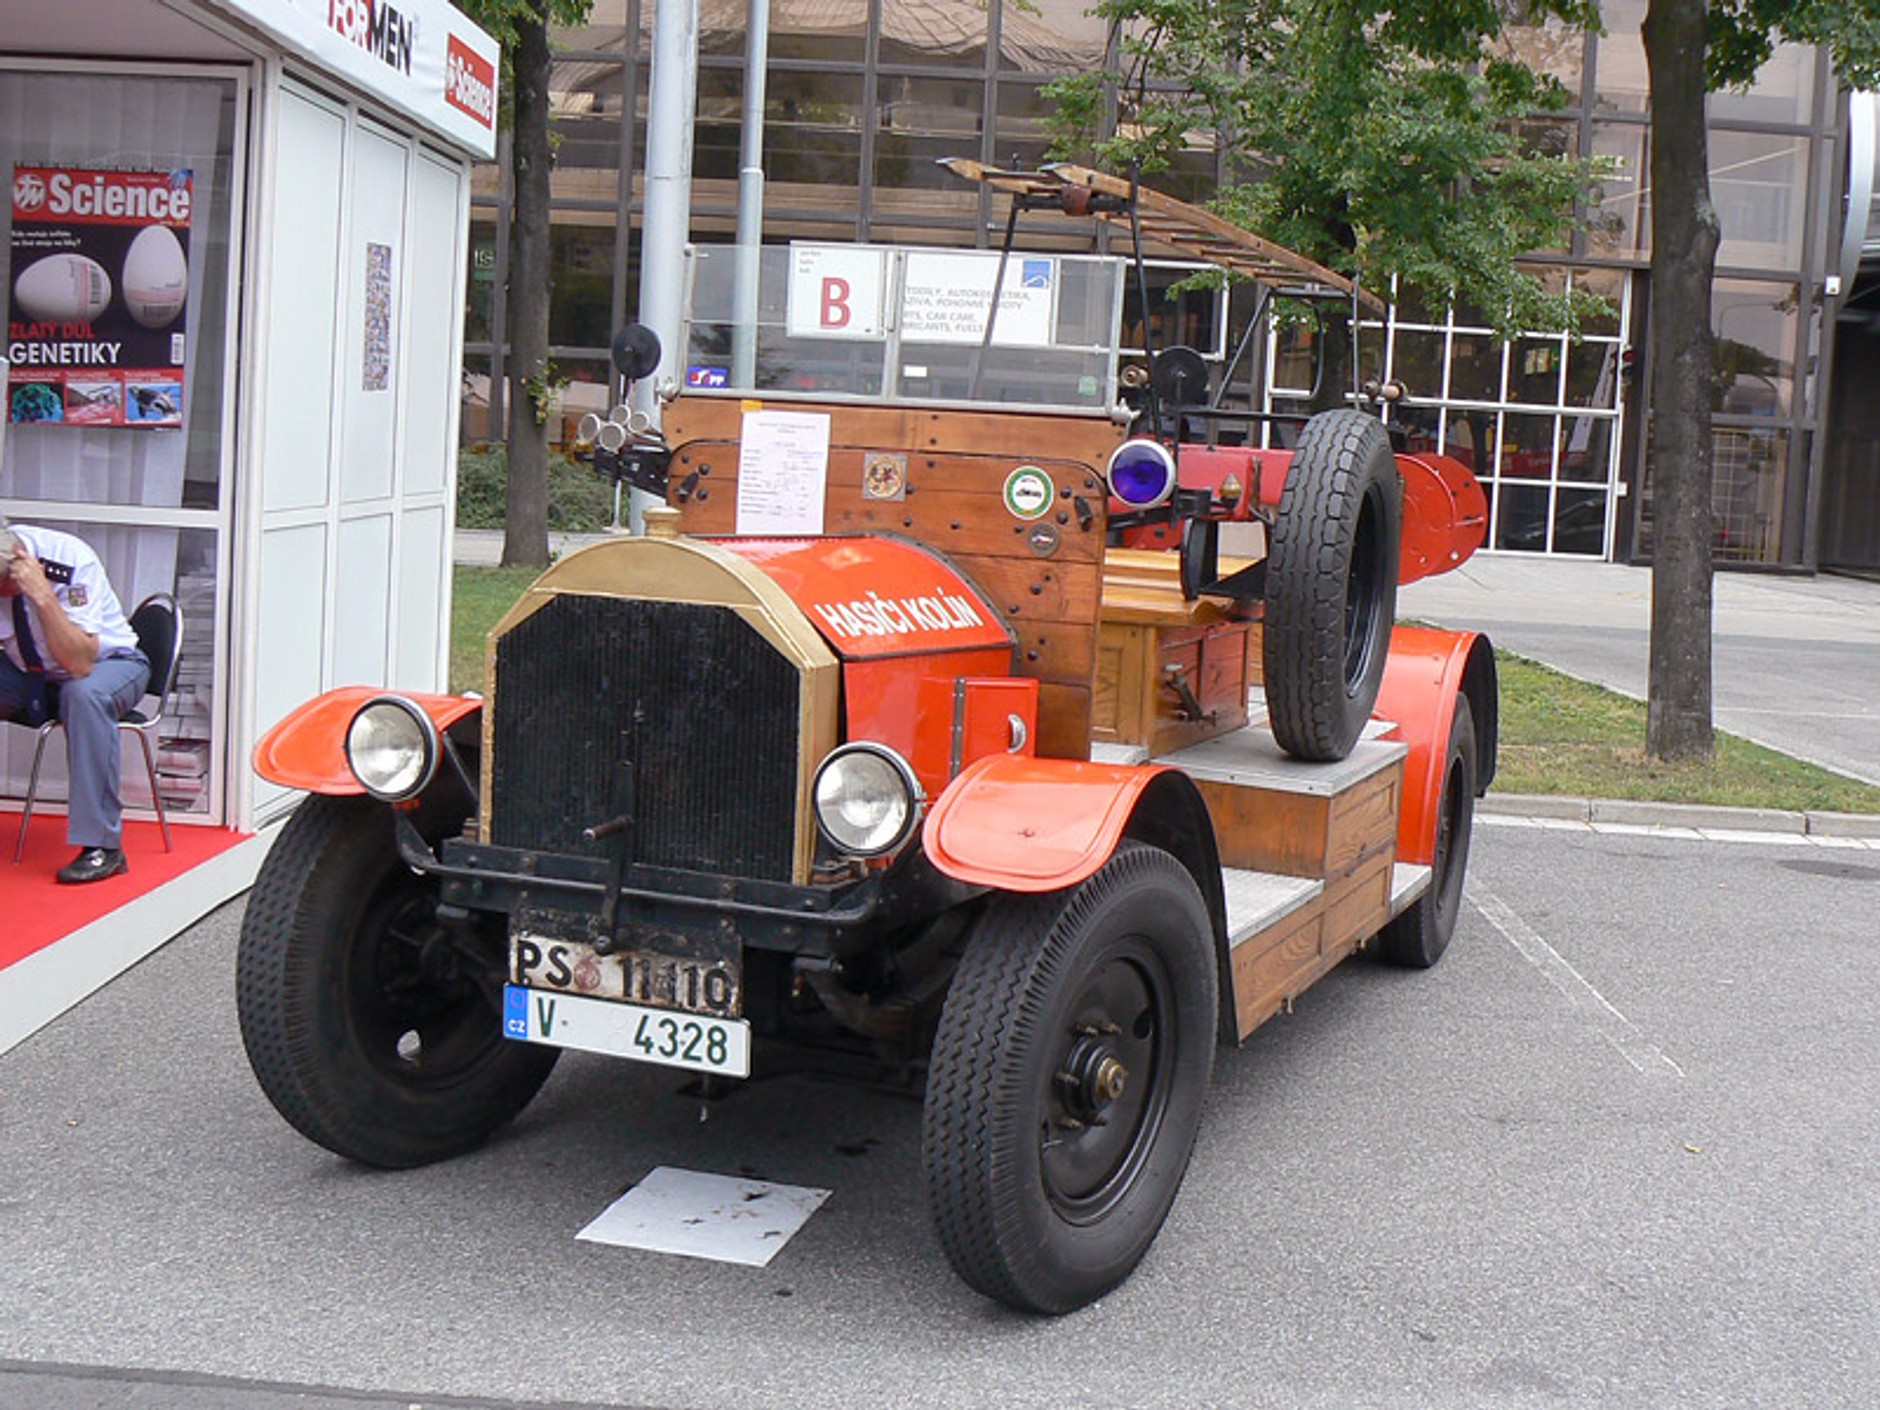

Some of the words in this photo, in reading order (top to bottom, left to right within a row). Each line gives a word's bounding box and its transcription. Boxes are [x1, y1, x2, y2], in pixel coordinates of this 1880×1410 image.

[455, 55, 493, 121] Science
[50, 173, 190, 219] Science
[821, 277, 851, 330] B
[8, 342, 122, 365] GENETIKY
[517, 939, 573, 988] PS
[508, 1019, 526, 1034] CZ
[537, 996, 556, 1038] V
[634, 1014, 728, 1066] 4328
